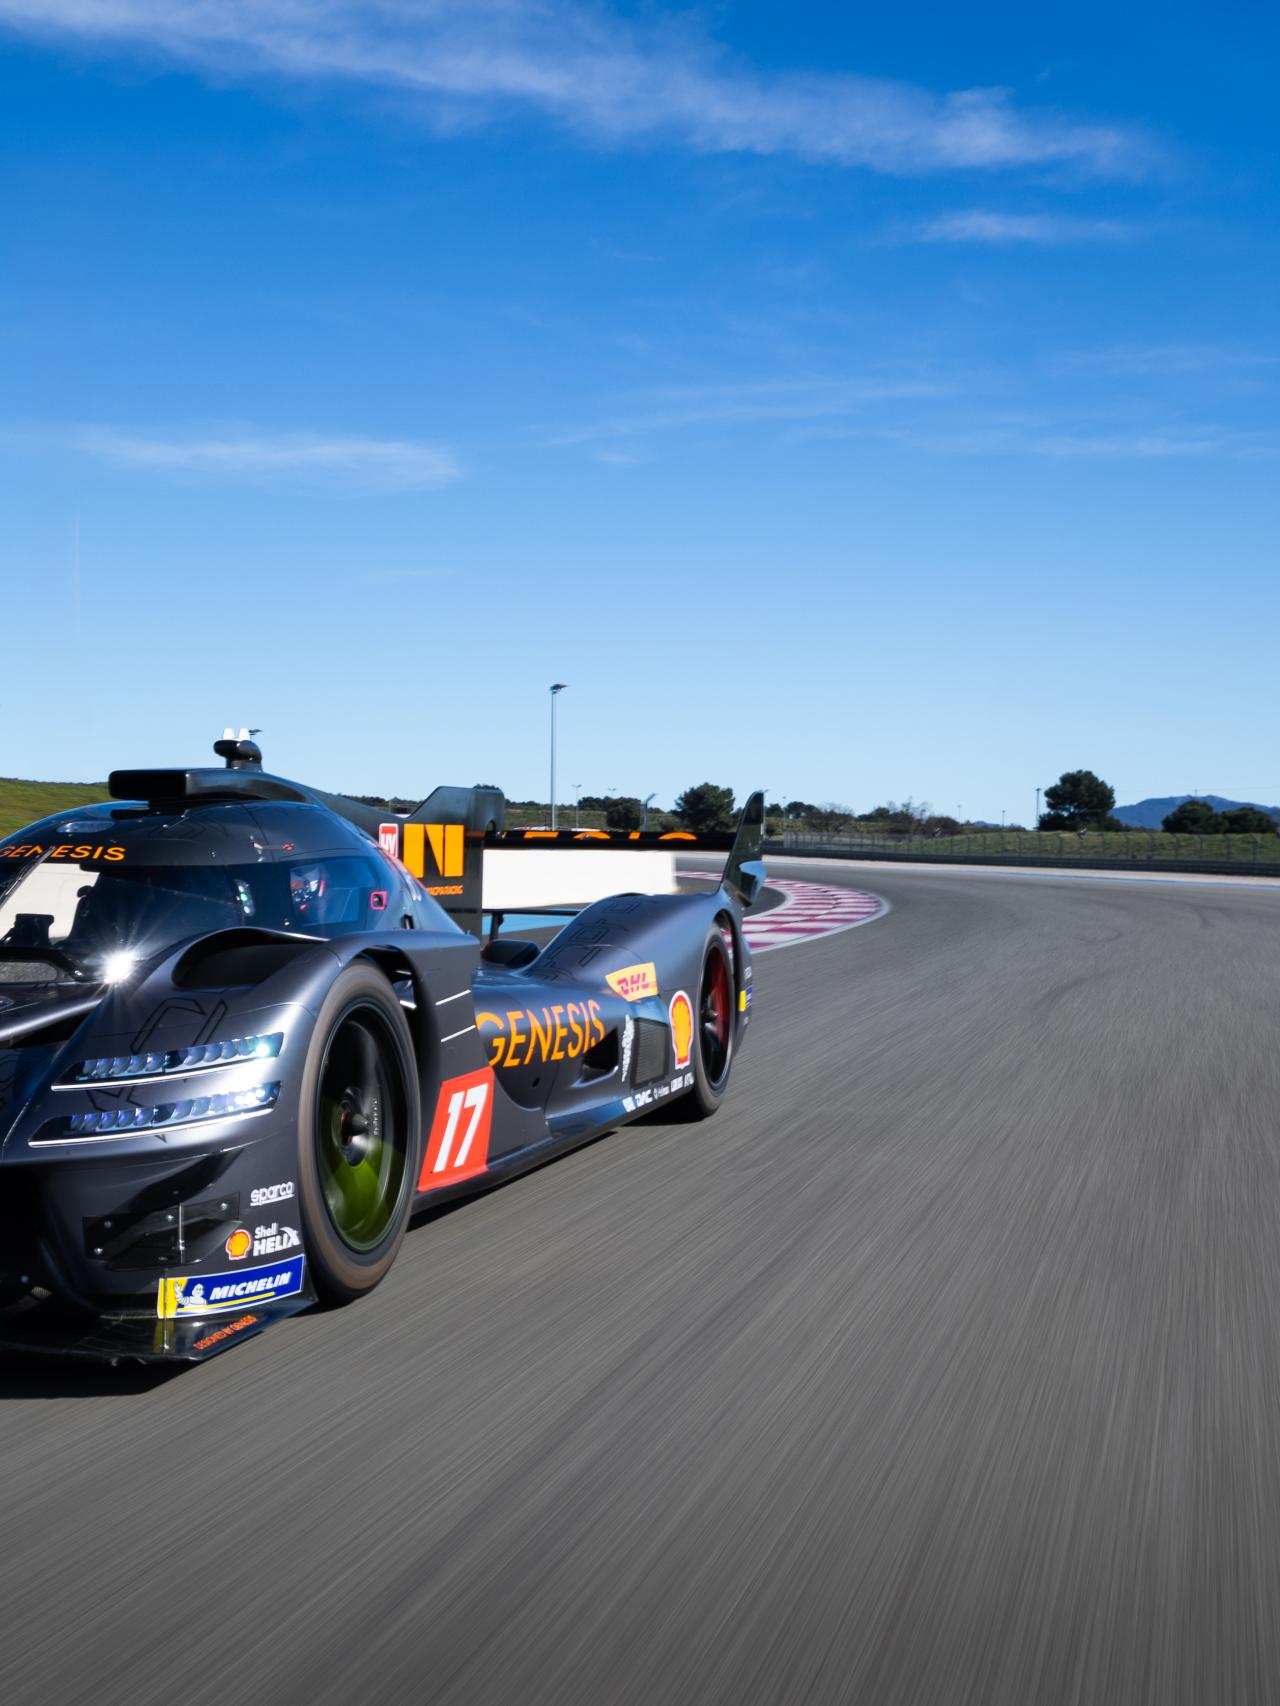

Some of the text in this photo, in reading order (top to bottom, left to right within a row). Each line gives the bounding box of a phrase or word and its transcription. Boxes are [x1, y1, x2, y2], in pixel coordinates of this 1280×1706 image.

[616, 972, 651, 996] DHL
[475, 999, 605, 1067] GENESIS
[433, 1083, 489, 1173] 17
[250, 1181, 295, 1206] sparco
[252, 1227, 301, 1257] HELIX
[254, 1222, 279, 1240] Shell
[209, 1271, 292, 1300] MICHELIN
